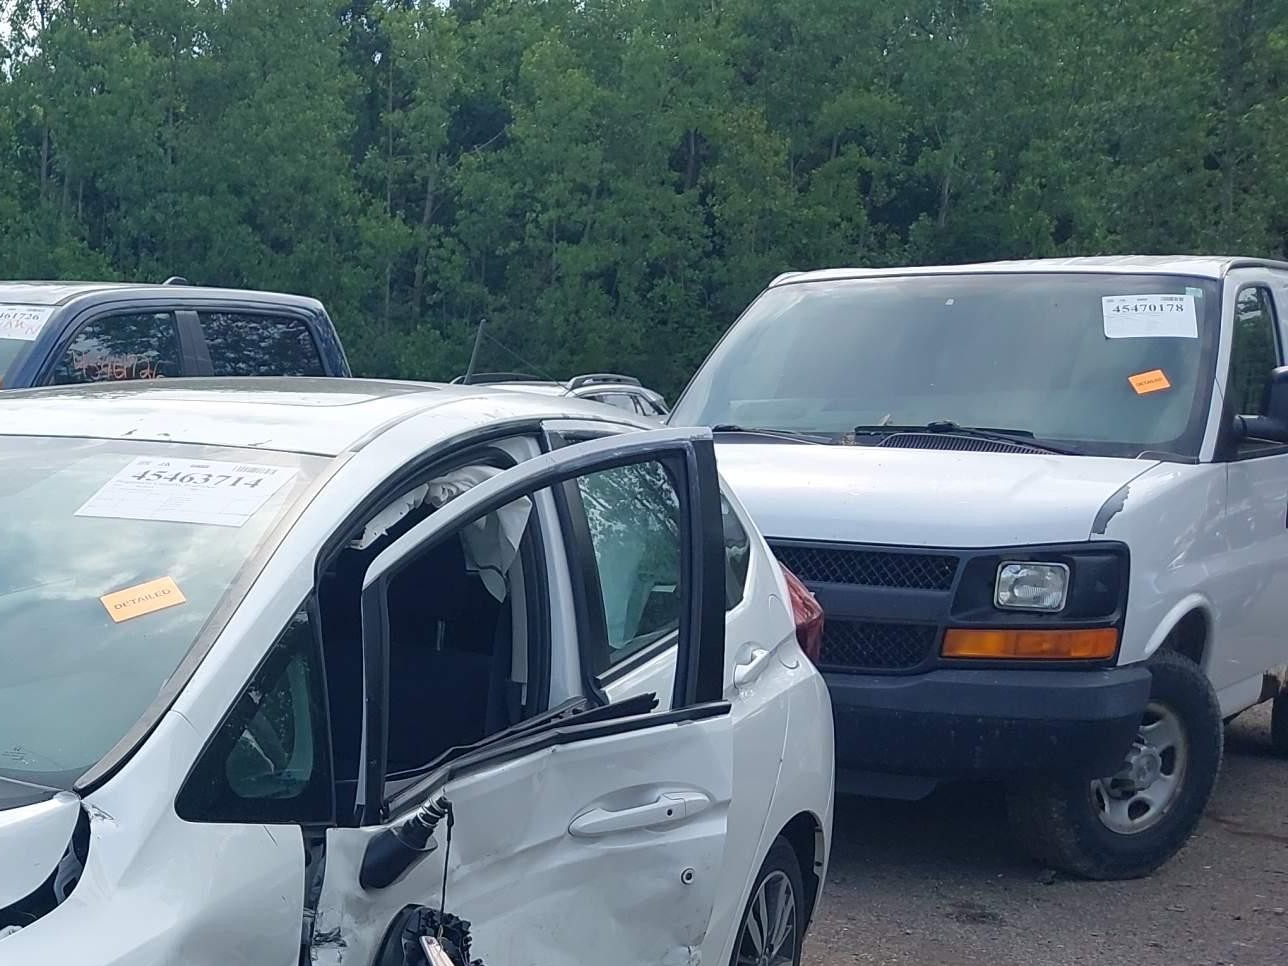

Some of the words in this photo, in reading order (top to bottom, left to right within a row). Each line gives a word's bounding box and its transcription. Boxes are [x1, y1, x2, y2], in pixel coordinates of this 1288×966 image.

[1112, 303, 1184, 313] 45470178
[130, 468, 265, 490] 45463714
[113, 587, 172, 611] DETAILED
